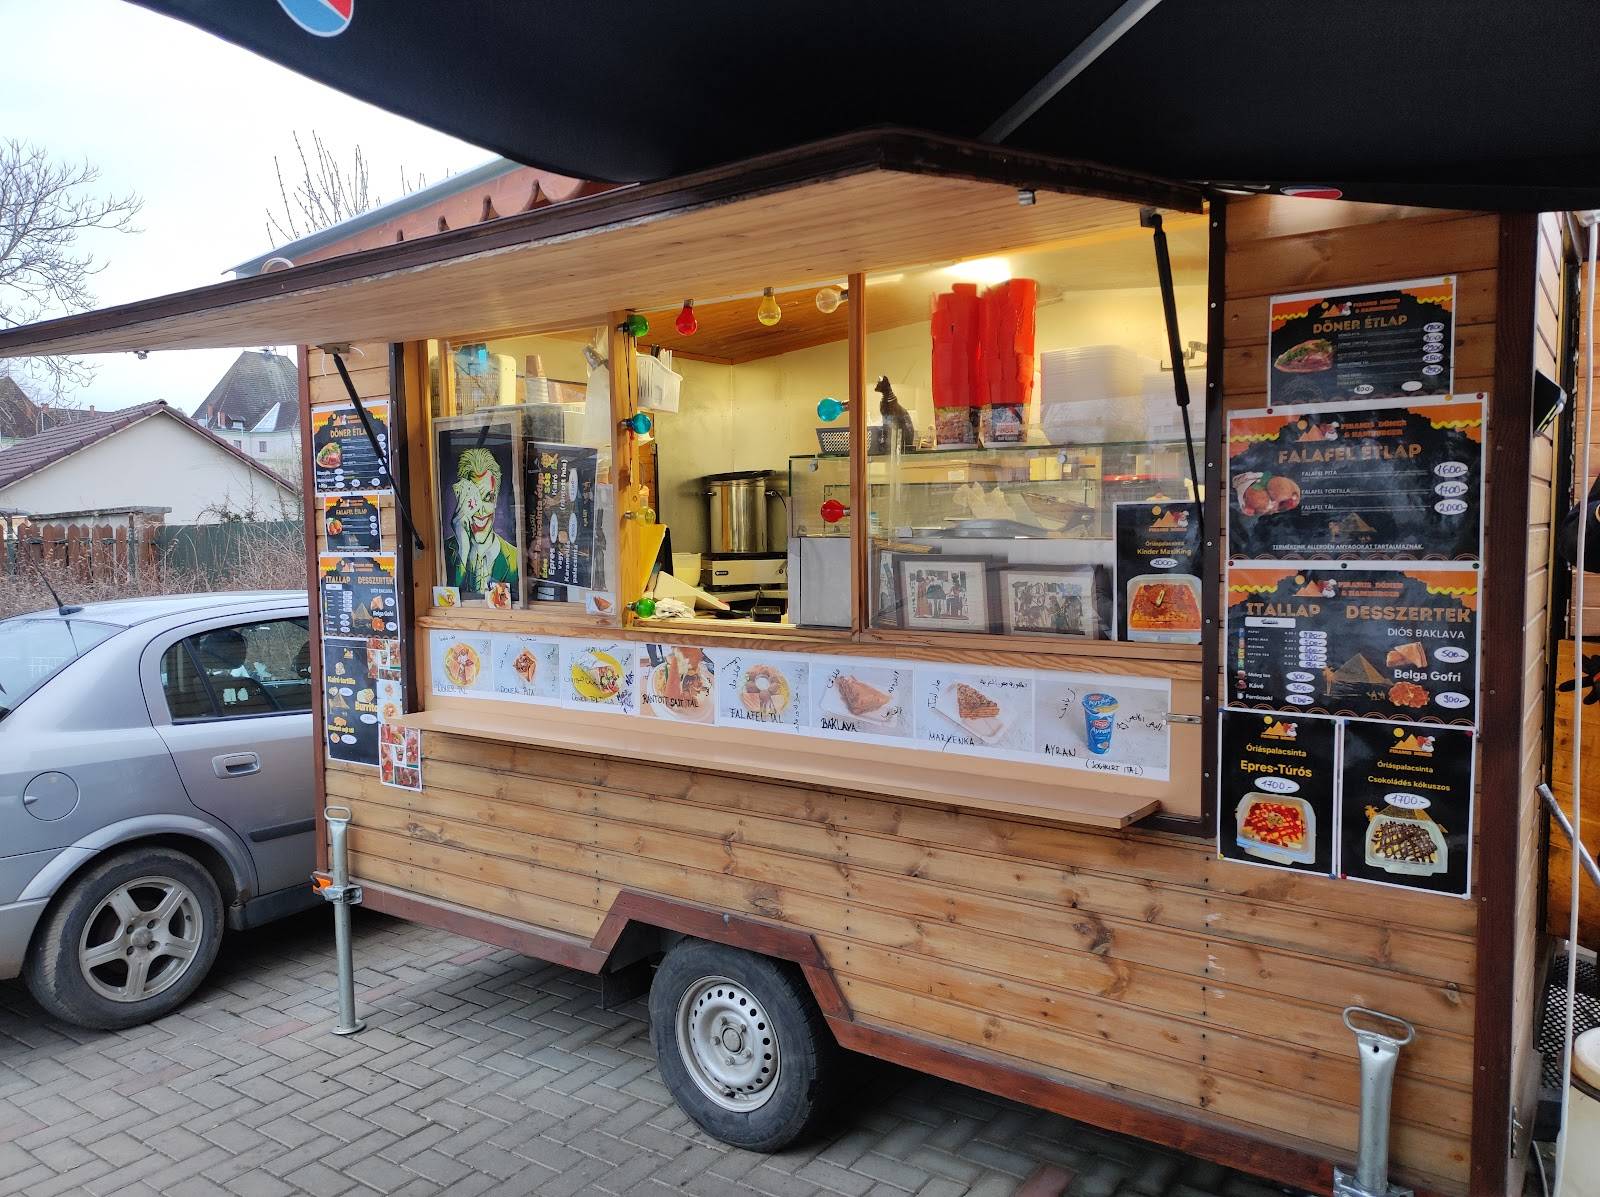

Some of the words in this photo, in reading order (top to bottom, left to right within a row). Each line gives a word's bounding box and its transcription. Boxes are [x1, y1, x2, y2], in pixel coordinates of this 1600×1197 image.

[1313, 320, 1360, 334] DÖNER
[1364, 315, 1407, 329] ÉTLAP
[330, 427, 351, 438] DÖNER
[352, 425, 368, 436] ÉTLA
[1278, 446, 1356, 464] FALAFEL
[1361, 441, 1422, 460] ÉTLAP
[1246, 602, 1321, 618] ITALLAP
[1346, 605, 1471, 623] DESSZERTEK
[1388, 627, 1413, 637] DIÓS
[1416, 629, 1466, 639] BAKLAVA
[1394, 669, 1427, 681] Belga
[1430, 671, 1461, 682] Gofri
[729, 707, 767, 723] FALAFEL
[820, 717, 860, 733] BAKLAVA
[1045, 743, 1076, 757] AYRAN
[1246, 743, 1307, 757] Óriáspalacsinta
[1240, 759, 1313, 778] Epres-Túrós
[1377, 760, 1434, 773] Óriáspalacsinta
[1367, 775, 1412, 787] Csokoládés
[1413, 780, 1451, 791] kókuszos
